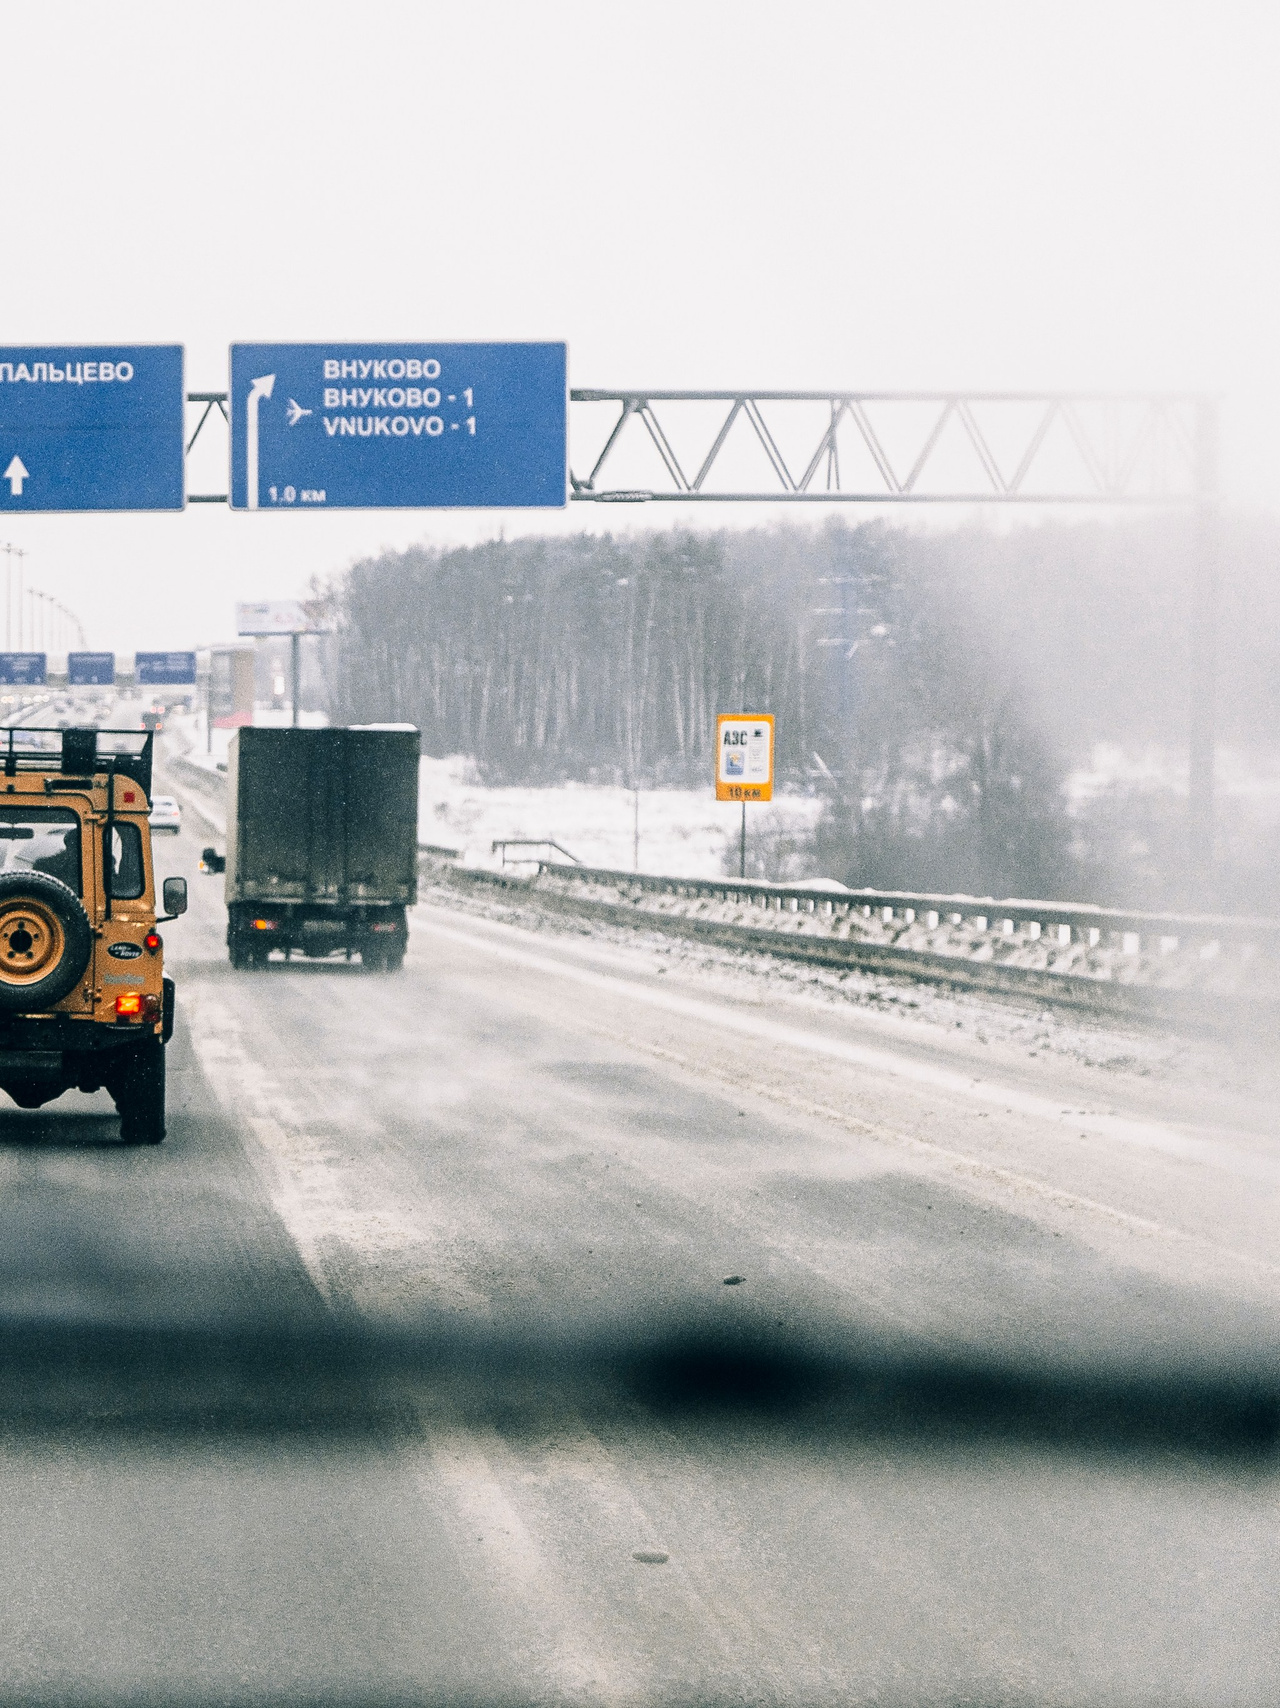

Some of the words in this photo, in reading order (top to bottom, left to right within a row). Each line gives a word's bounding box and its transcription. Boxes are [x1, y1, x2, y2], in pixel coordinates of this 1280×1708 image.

[323, 358, 441, 379] ВНУКОВО
[323, 387, 441, 408] ВНУКОВО
[463, 387, 474, 407] 1
[323, 416, 444, 436] VNUKOVO
[466, 416, 477, 435] 1
[269, 485, 296, 503] 1.0
[301, 490, 326, 503] км
[723, 730, 747, 745] АЗС
